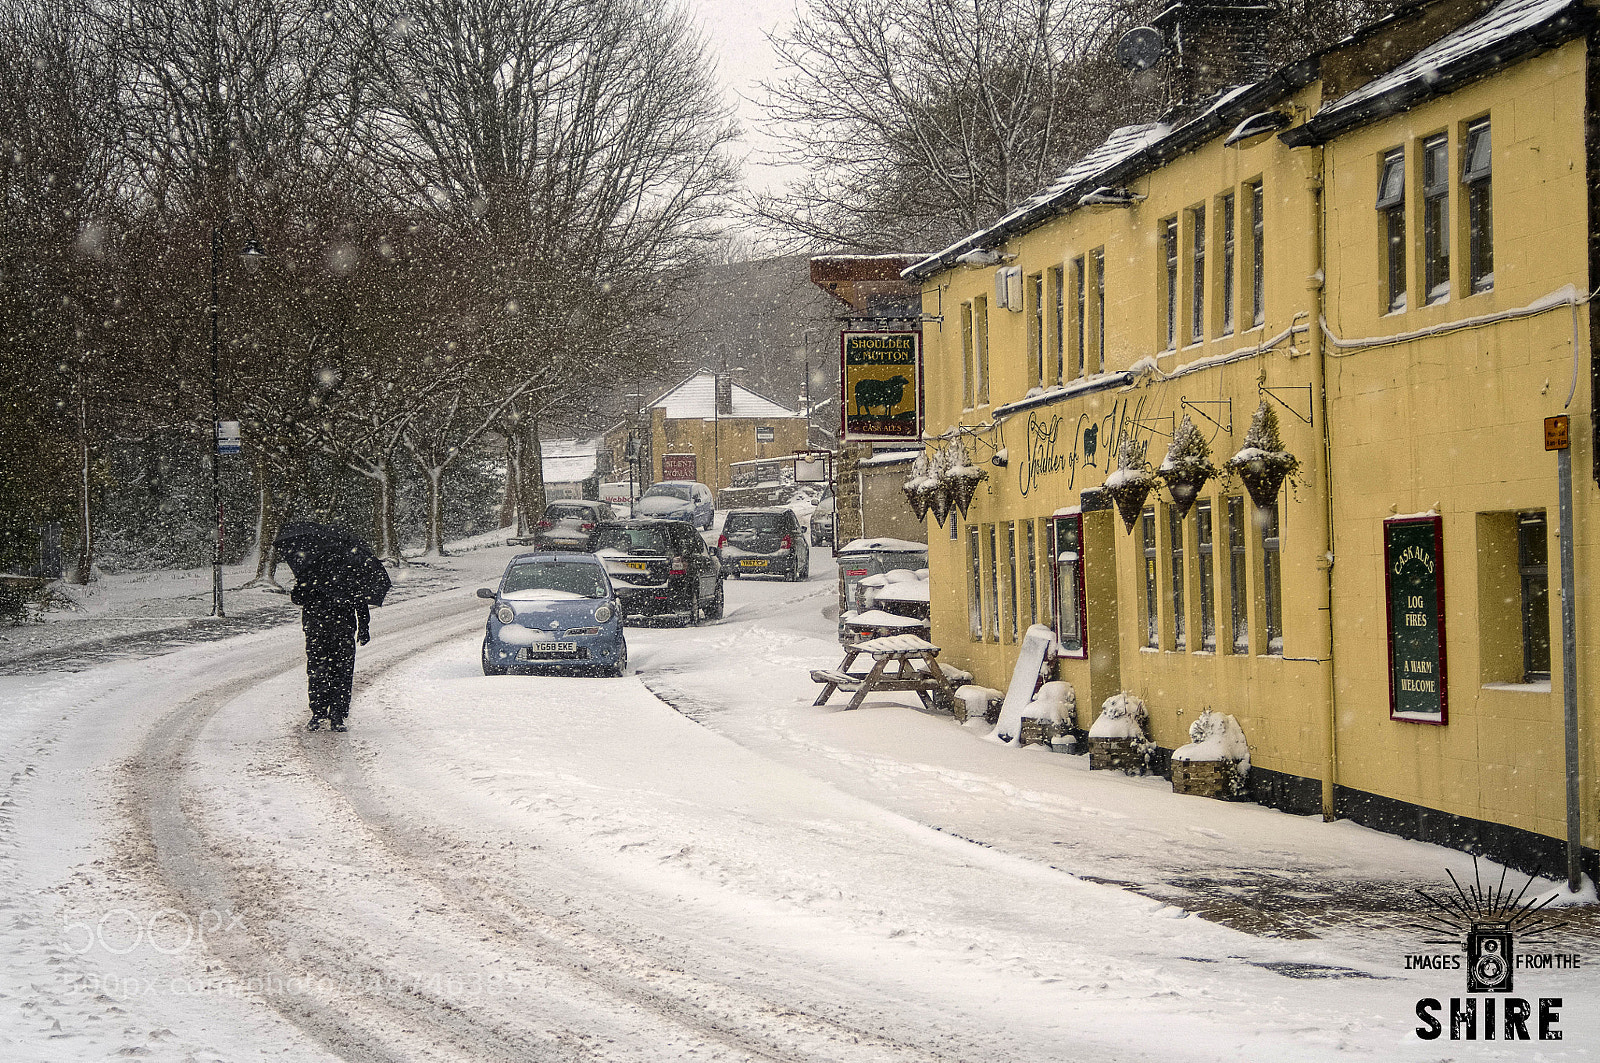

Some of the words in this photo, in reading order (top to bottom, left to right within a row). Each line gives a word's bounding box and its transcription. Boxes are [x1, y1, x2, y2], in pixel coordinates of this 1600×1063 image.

[852, 339, 910, 349] SHOULDER
[862, 351, 909, 360] MUTTON
[1394, 545, 1414, 575] CASK
[1414, 545, 1434, 574] ALES
[1407, 595, 1424, 609] LOG
[1405, 613, 1427, 627] FIRES
[535, 643, 556, 651] YG58
[1403, 660, 1410, 672] A
[1410, 660, 1432, 674] WARM
[1401, 678, 1436, 693] WELCOME
